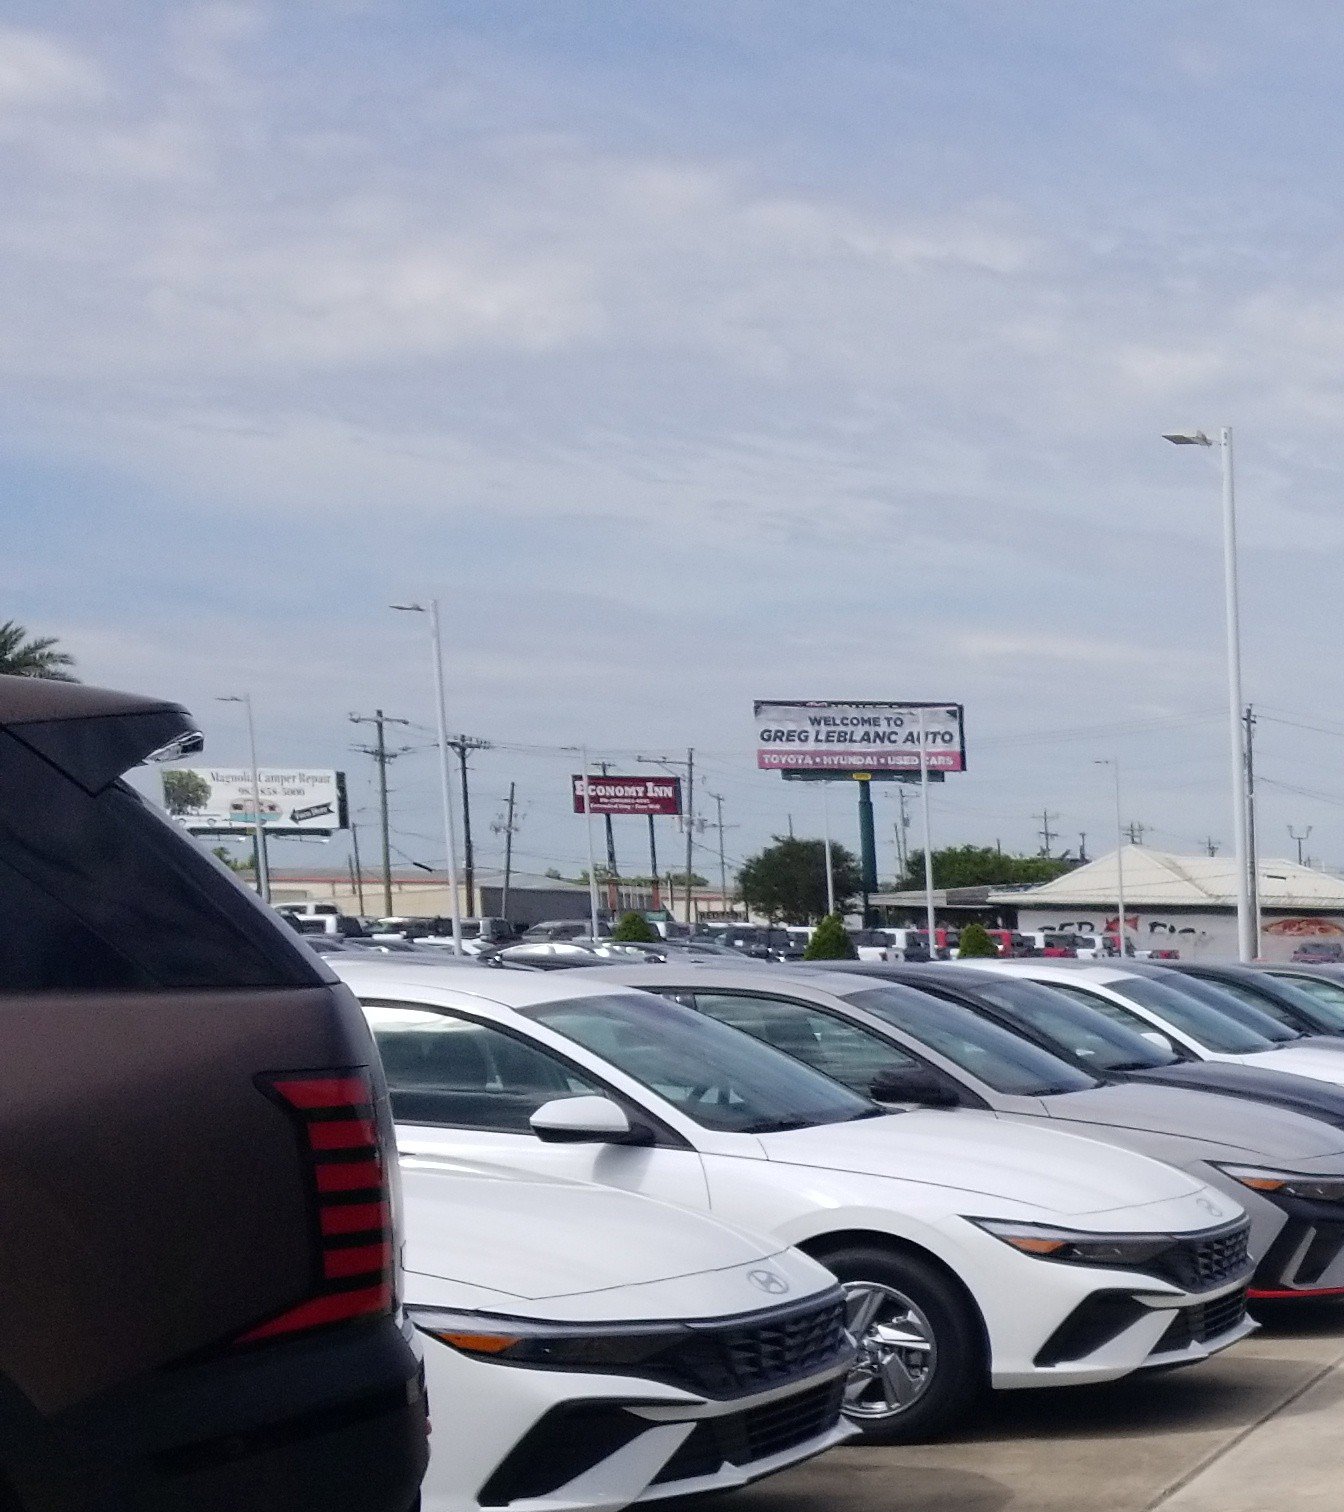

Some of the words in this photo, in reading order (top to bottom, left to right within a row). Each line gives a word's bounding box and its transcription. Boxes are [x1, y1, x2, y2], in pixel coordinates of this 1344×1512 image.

[808, 716, 881, 728] WELCOME
[885, 716, 904, 728] TO
[759, 729, 809, 743] GREG
[813, 729, 898, 744] LEBLANC
[762, 754, 812, 765] TOYOTA
[823, 755, 878, 766] HYUNDAI
[574, 780, 644, 797] ECONOMY
[646, 782, 673, 797] INN
